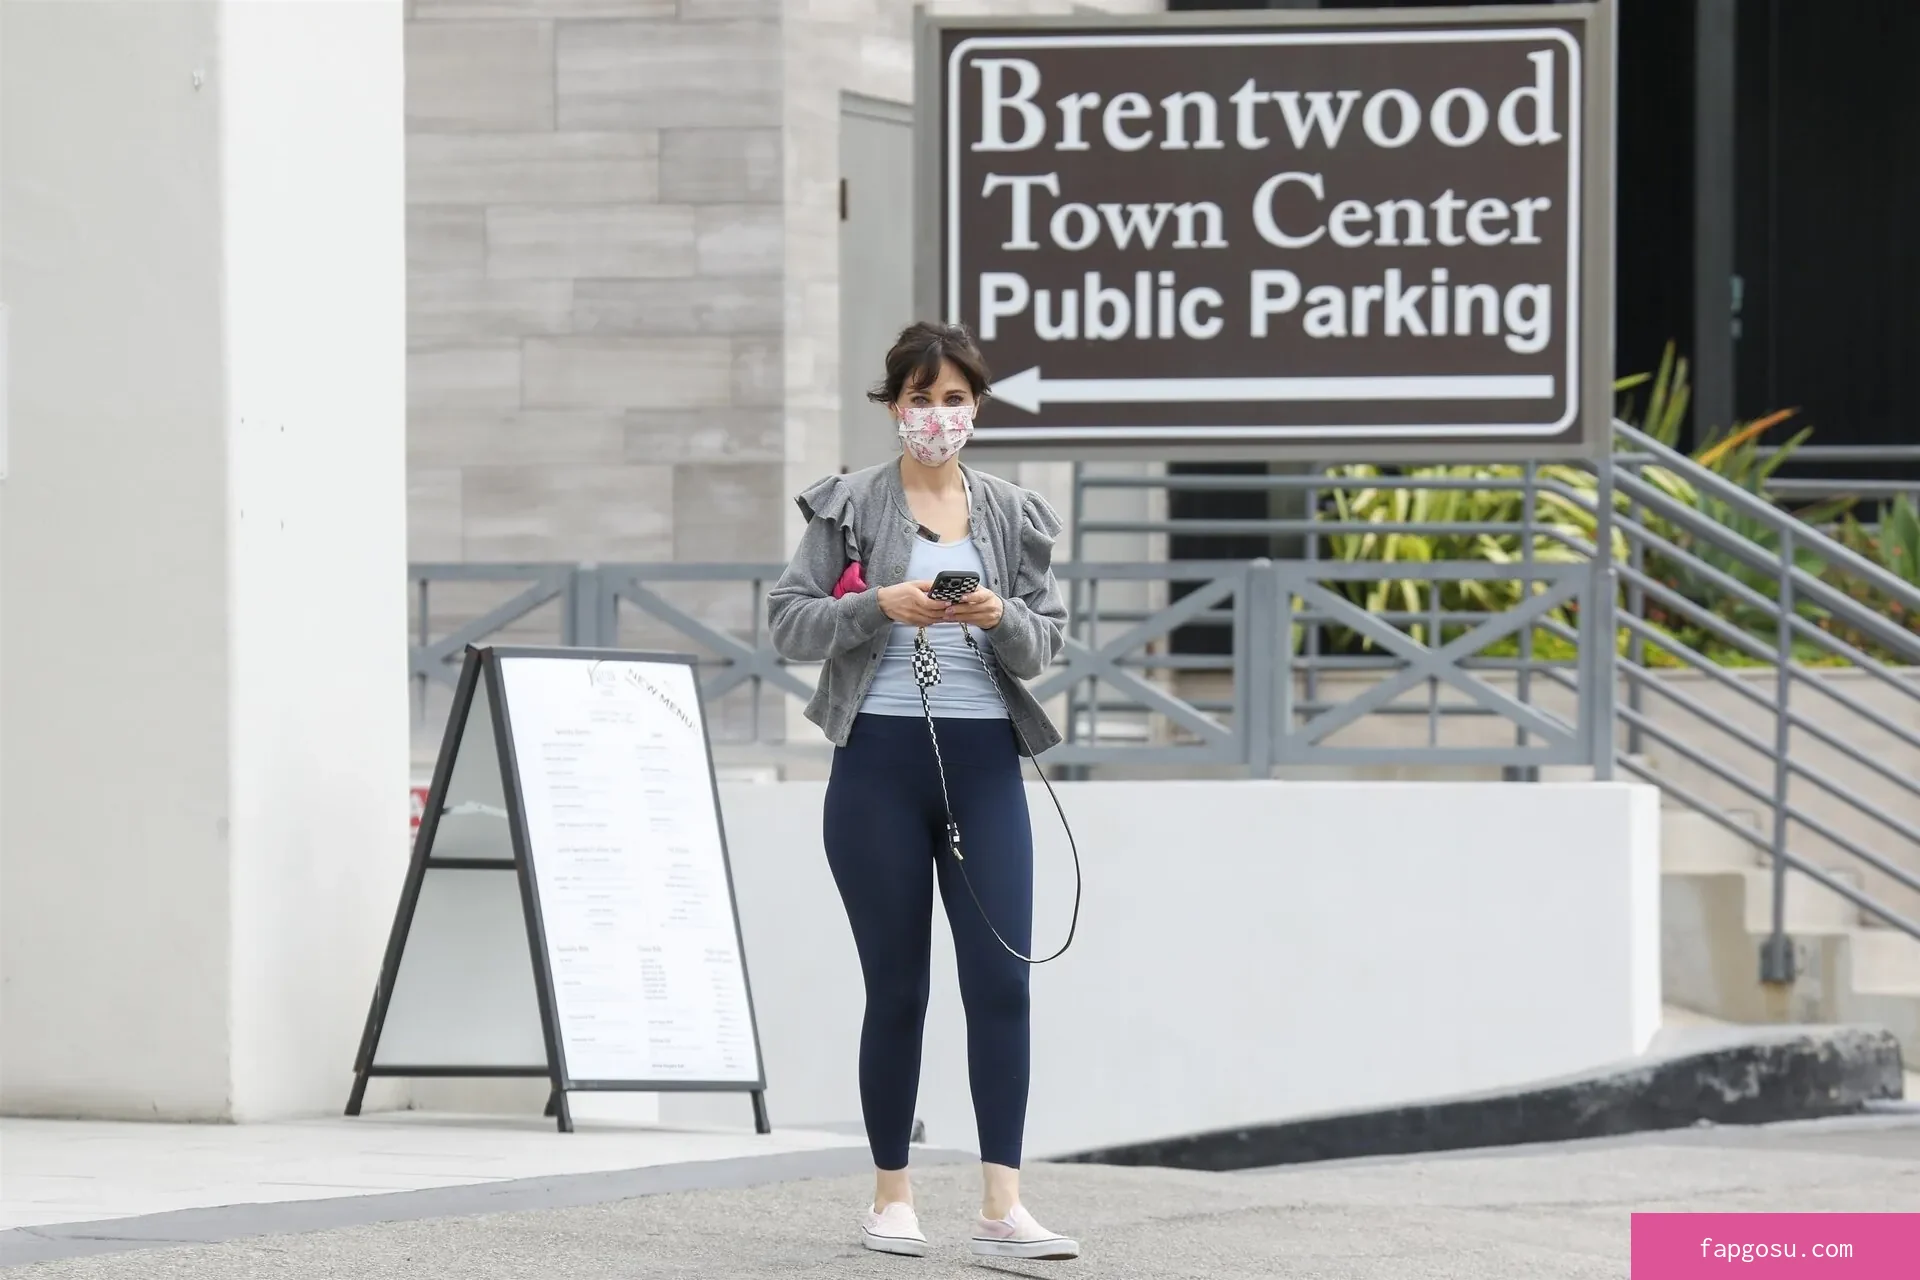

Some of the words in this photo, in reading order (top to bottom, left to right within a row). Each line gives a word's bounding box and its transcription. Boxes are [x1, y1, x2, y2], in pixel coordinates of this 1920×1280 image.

[970, 50, 1561, 153] Brentwood
[982, 172, 1228, 251] Town
[1253, 171, 1551, 249] Center
[979, 270, 1224, 341] Public
[1250, 267, 1551, 354] Parking
[628, 668, 658, 695] NEW
